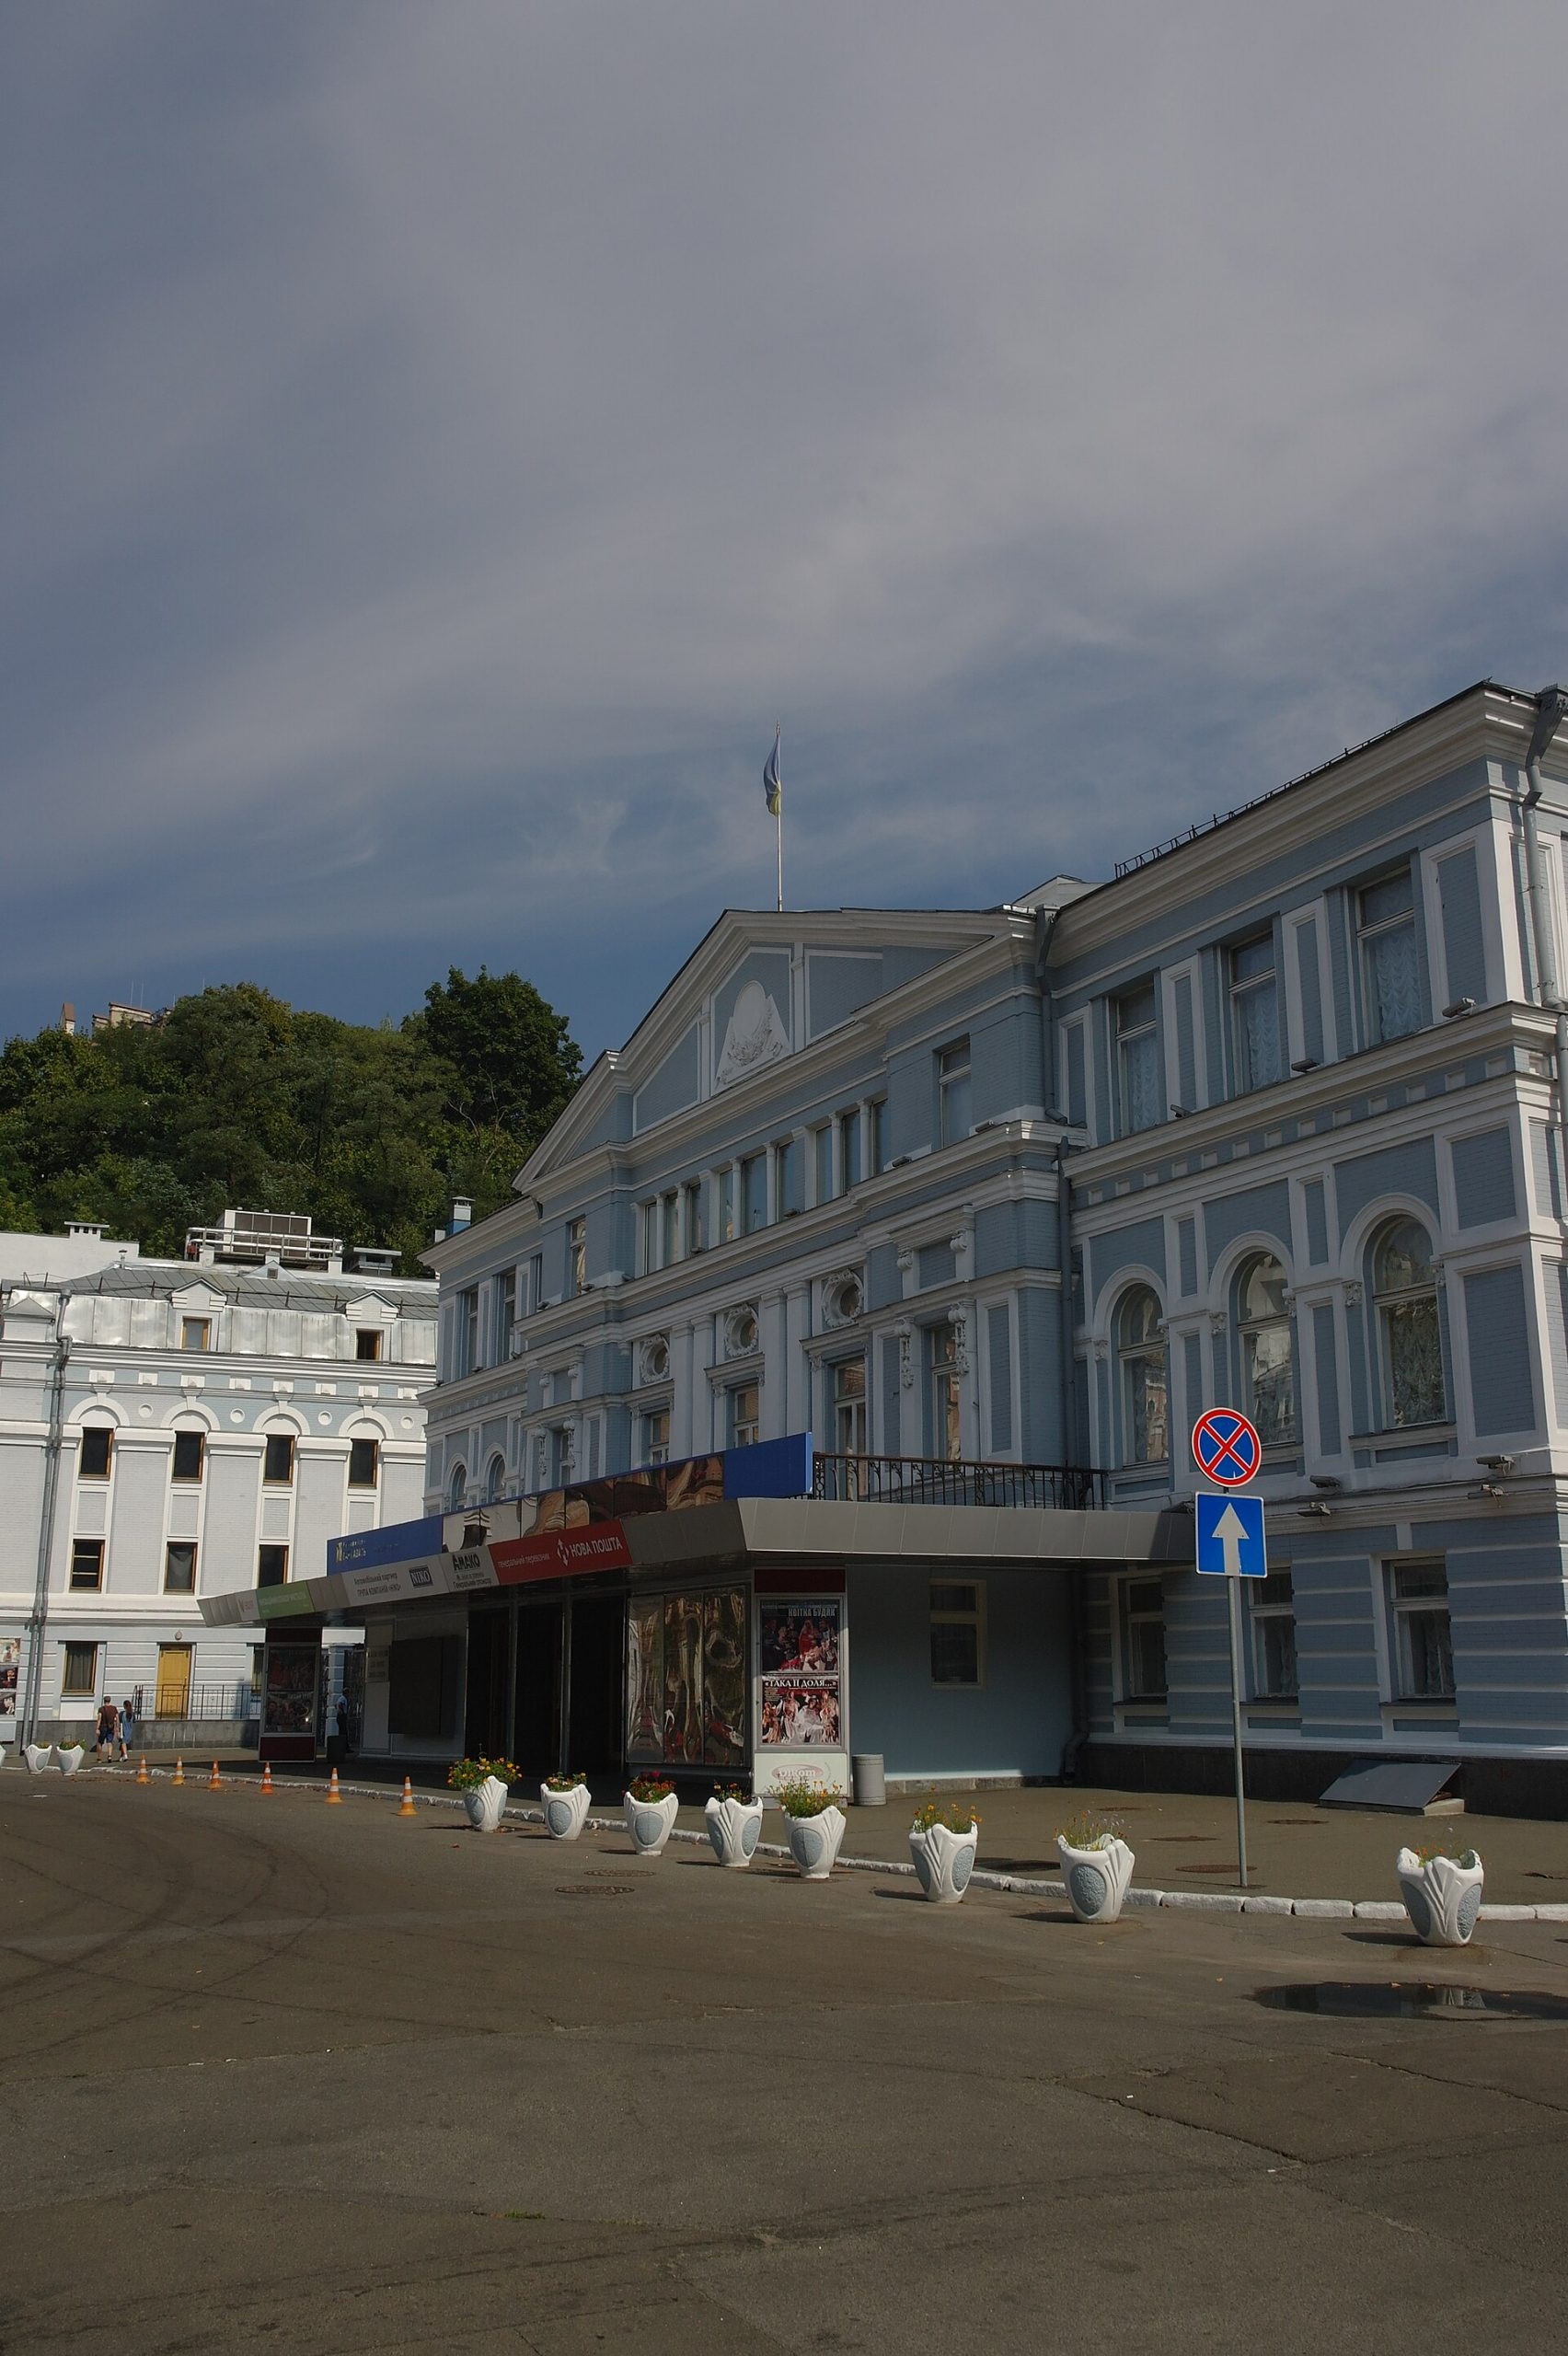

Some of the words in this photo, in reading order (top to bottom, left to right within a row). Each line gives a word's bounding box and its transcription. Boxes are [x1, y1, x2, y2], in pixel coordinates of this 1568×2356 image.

[569, 1542, 593, 1557] НОВА
[592, 1537, 623, 1553] ПОШТА
[411, 1570, 430, 1585] NIKO
[789, 1608, 812, 1617] КВІТКА
[813, 1608, 836, 1618] БУДЯК
